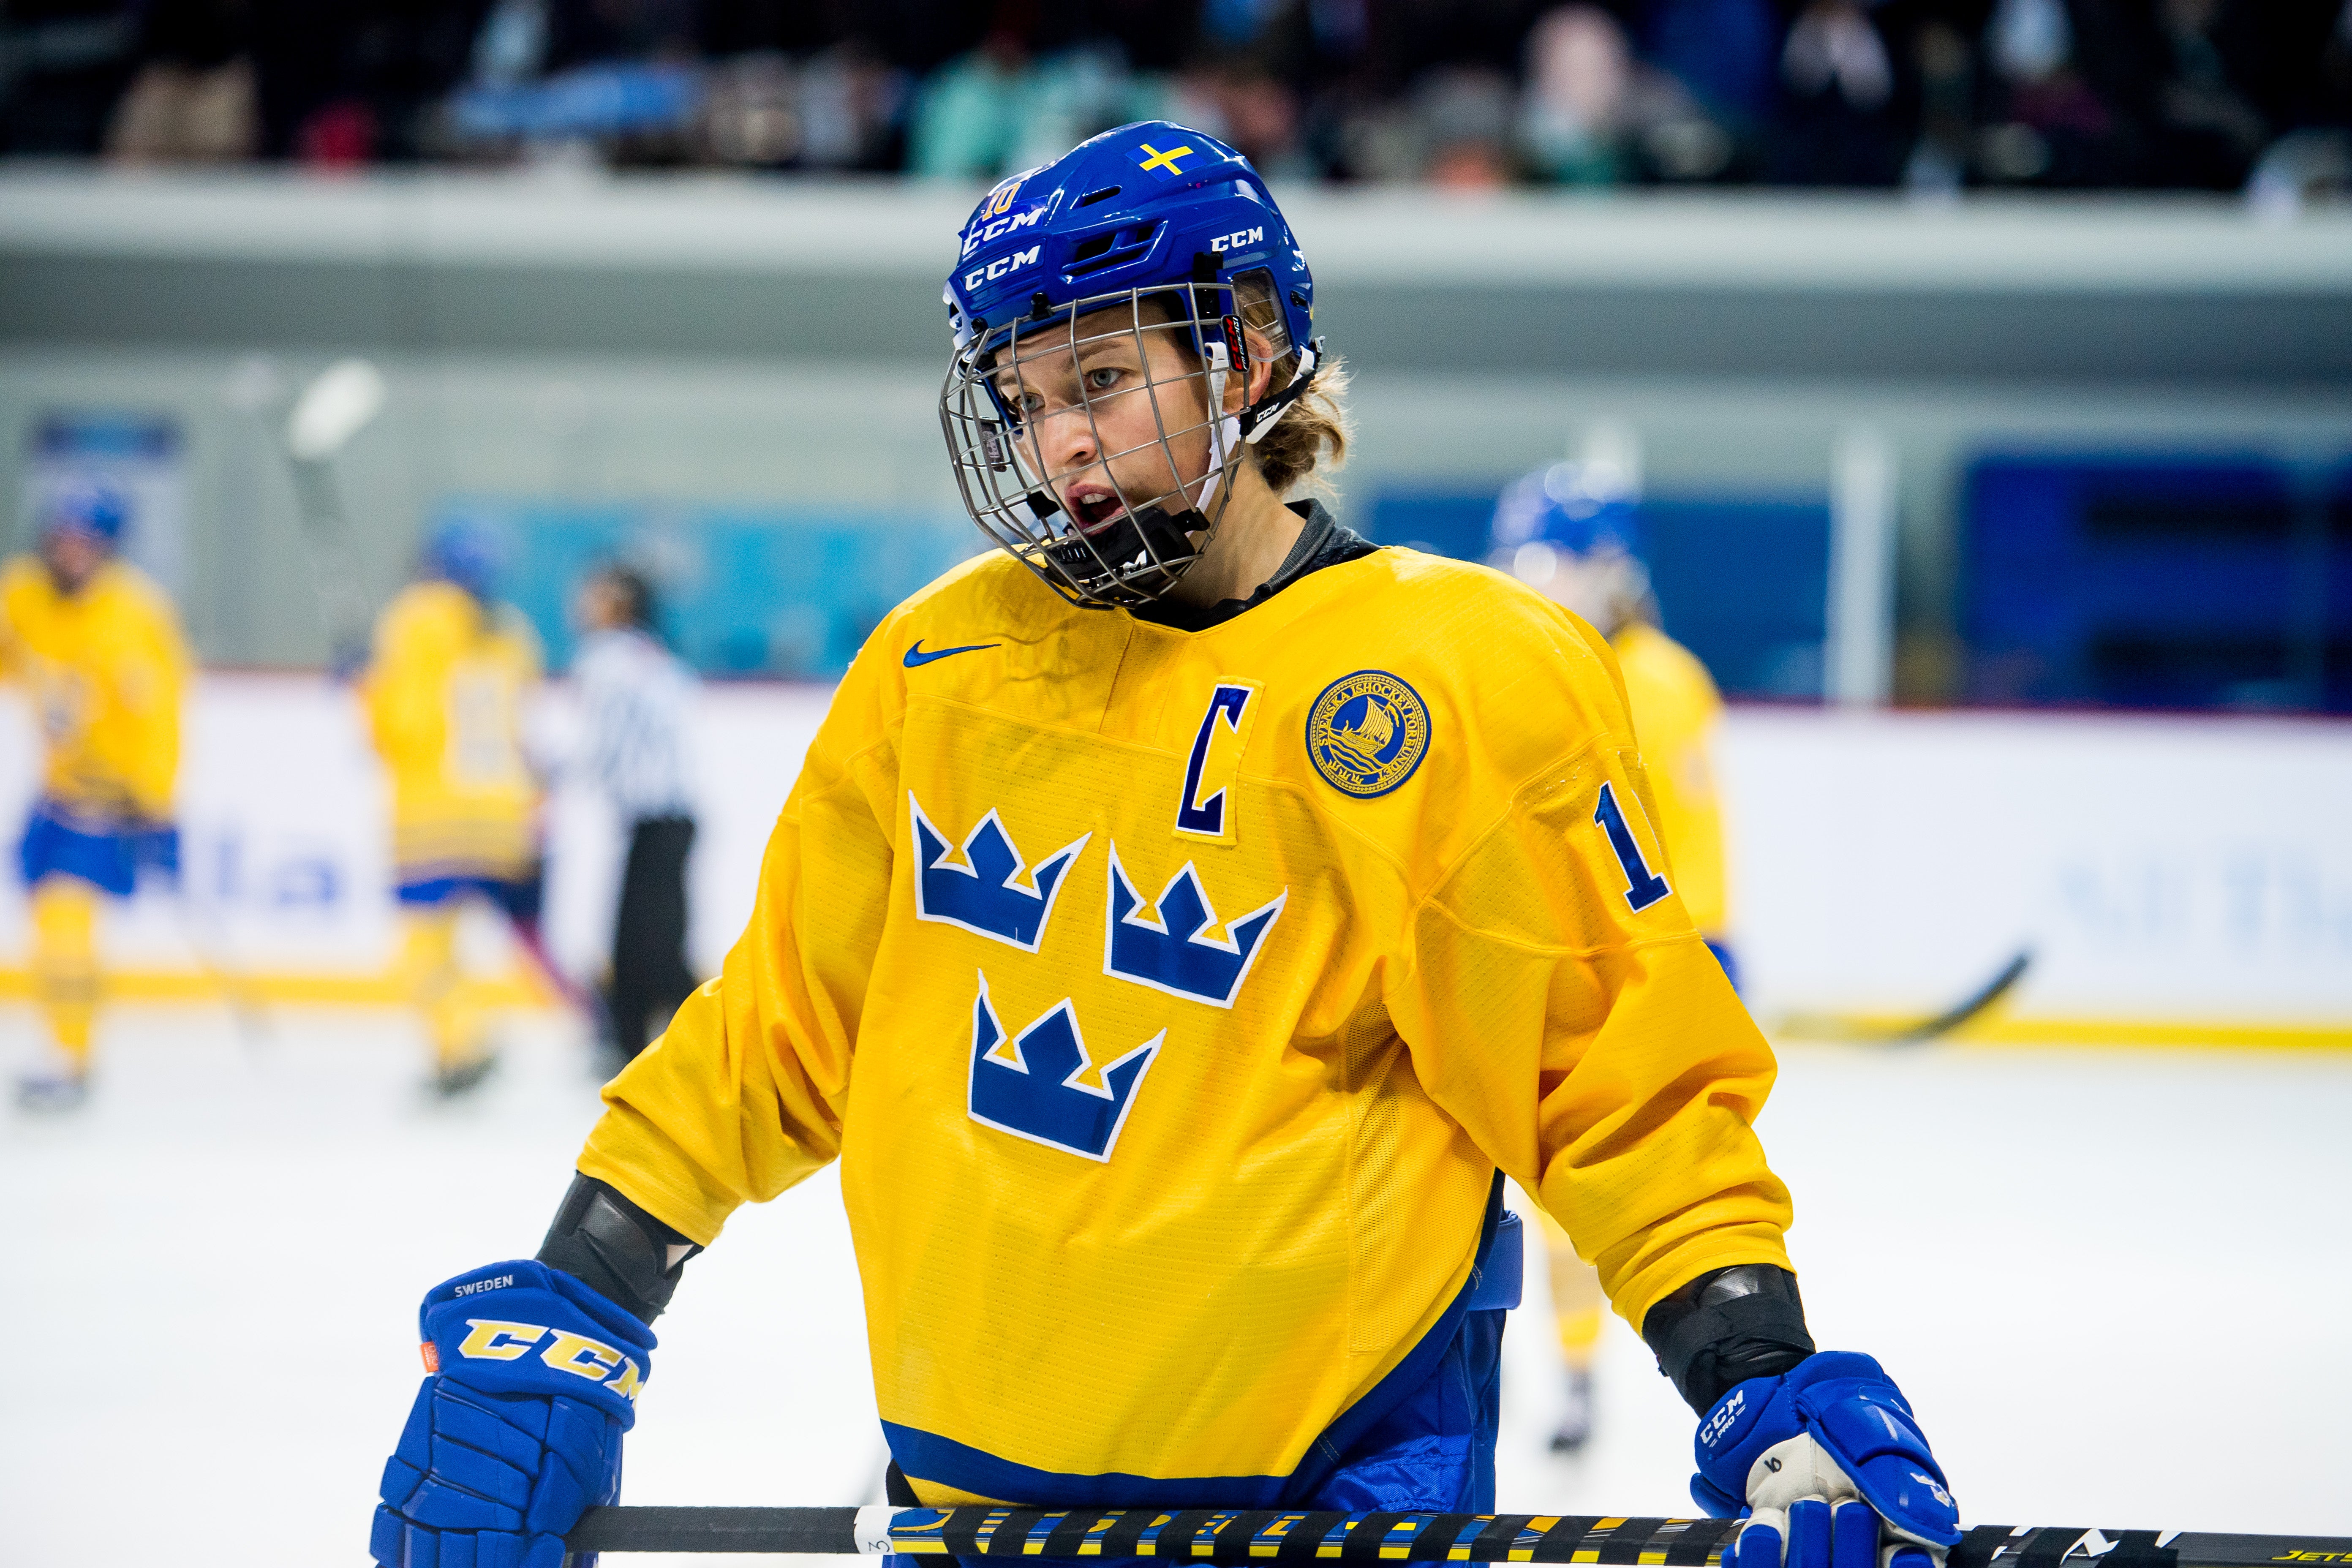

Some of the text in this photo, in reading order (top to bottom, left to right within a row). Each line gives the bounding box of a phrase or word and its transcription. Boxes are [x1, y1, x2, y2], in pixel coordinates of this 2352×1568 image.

[982, 182, 1021, 222] 10
[962, 207, 1045, 256] CCM
[1210, 226, 1263, 252] CCM
[965, 245, 1041, 291] CCM
[1226, 317, 1243, 370] CCM
[1256, 402, 1280, 423] CCM
[1318, 691, 1350, 746] SVENSKA
[1351, 682, 1412, 713] ISHOCKEY
[1176, 683, 1254, 836] C
[1593, 779, 1674, 914] 1
[455, 1274, 514, 1298] SWEDEN
[1700, 1390, 1743, 1443] CCM
[1717, 1416, 1735, 1438] PRO
